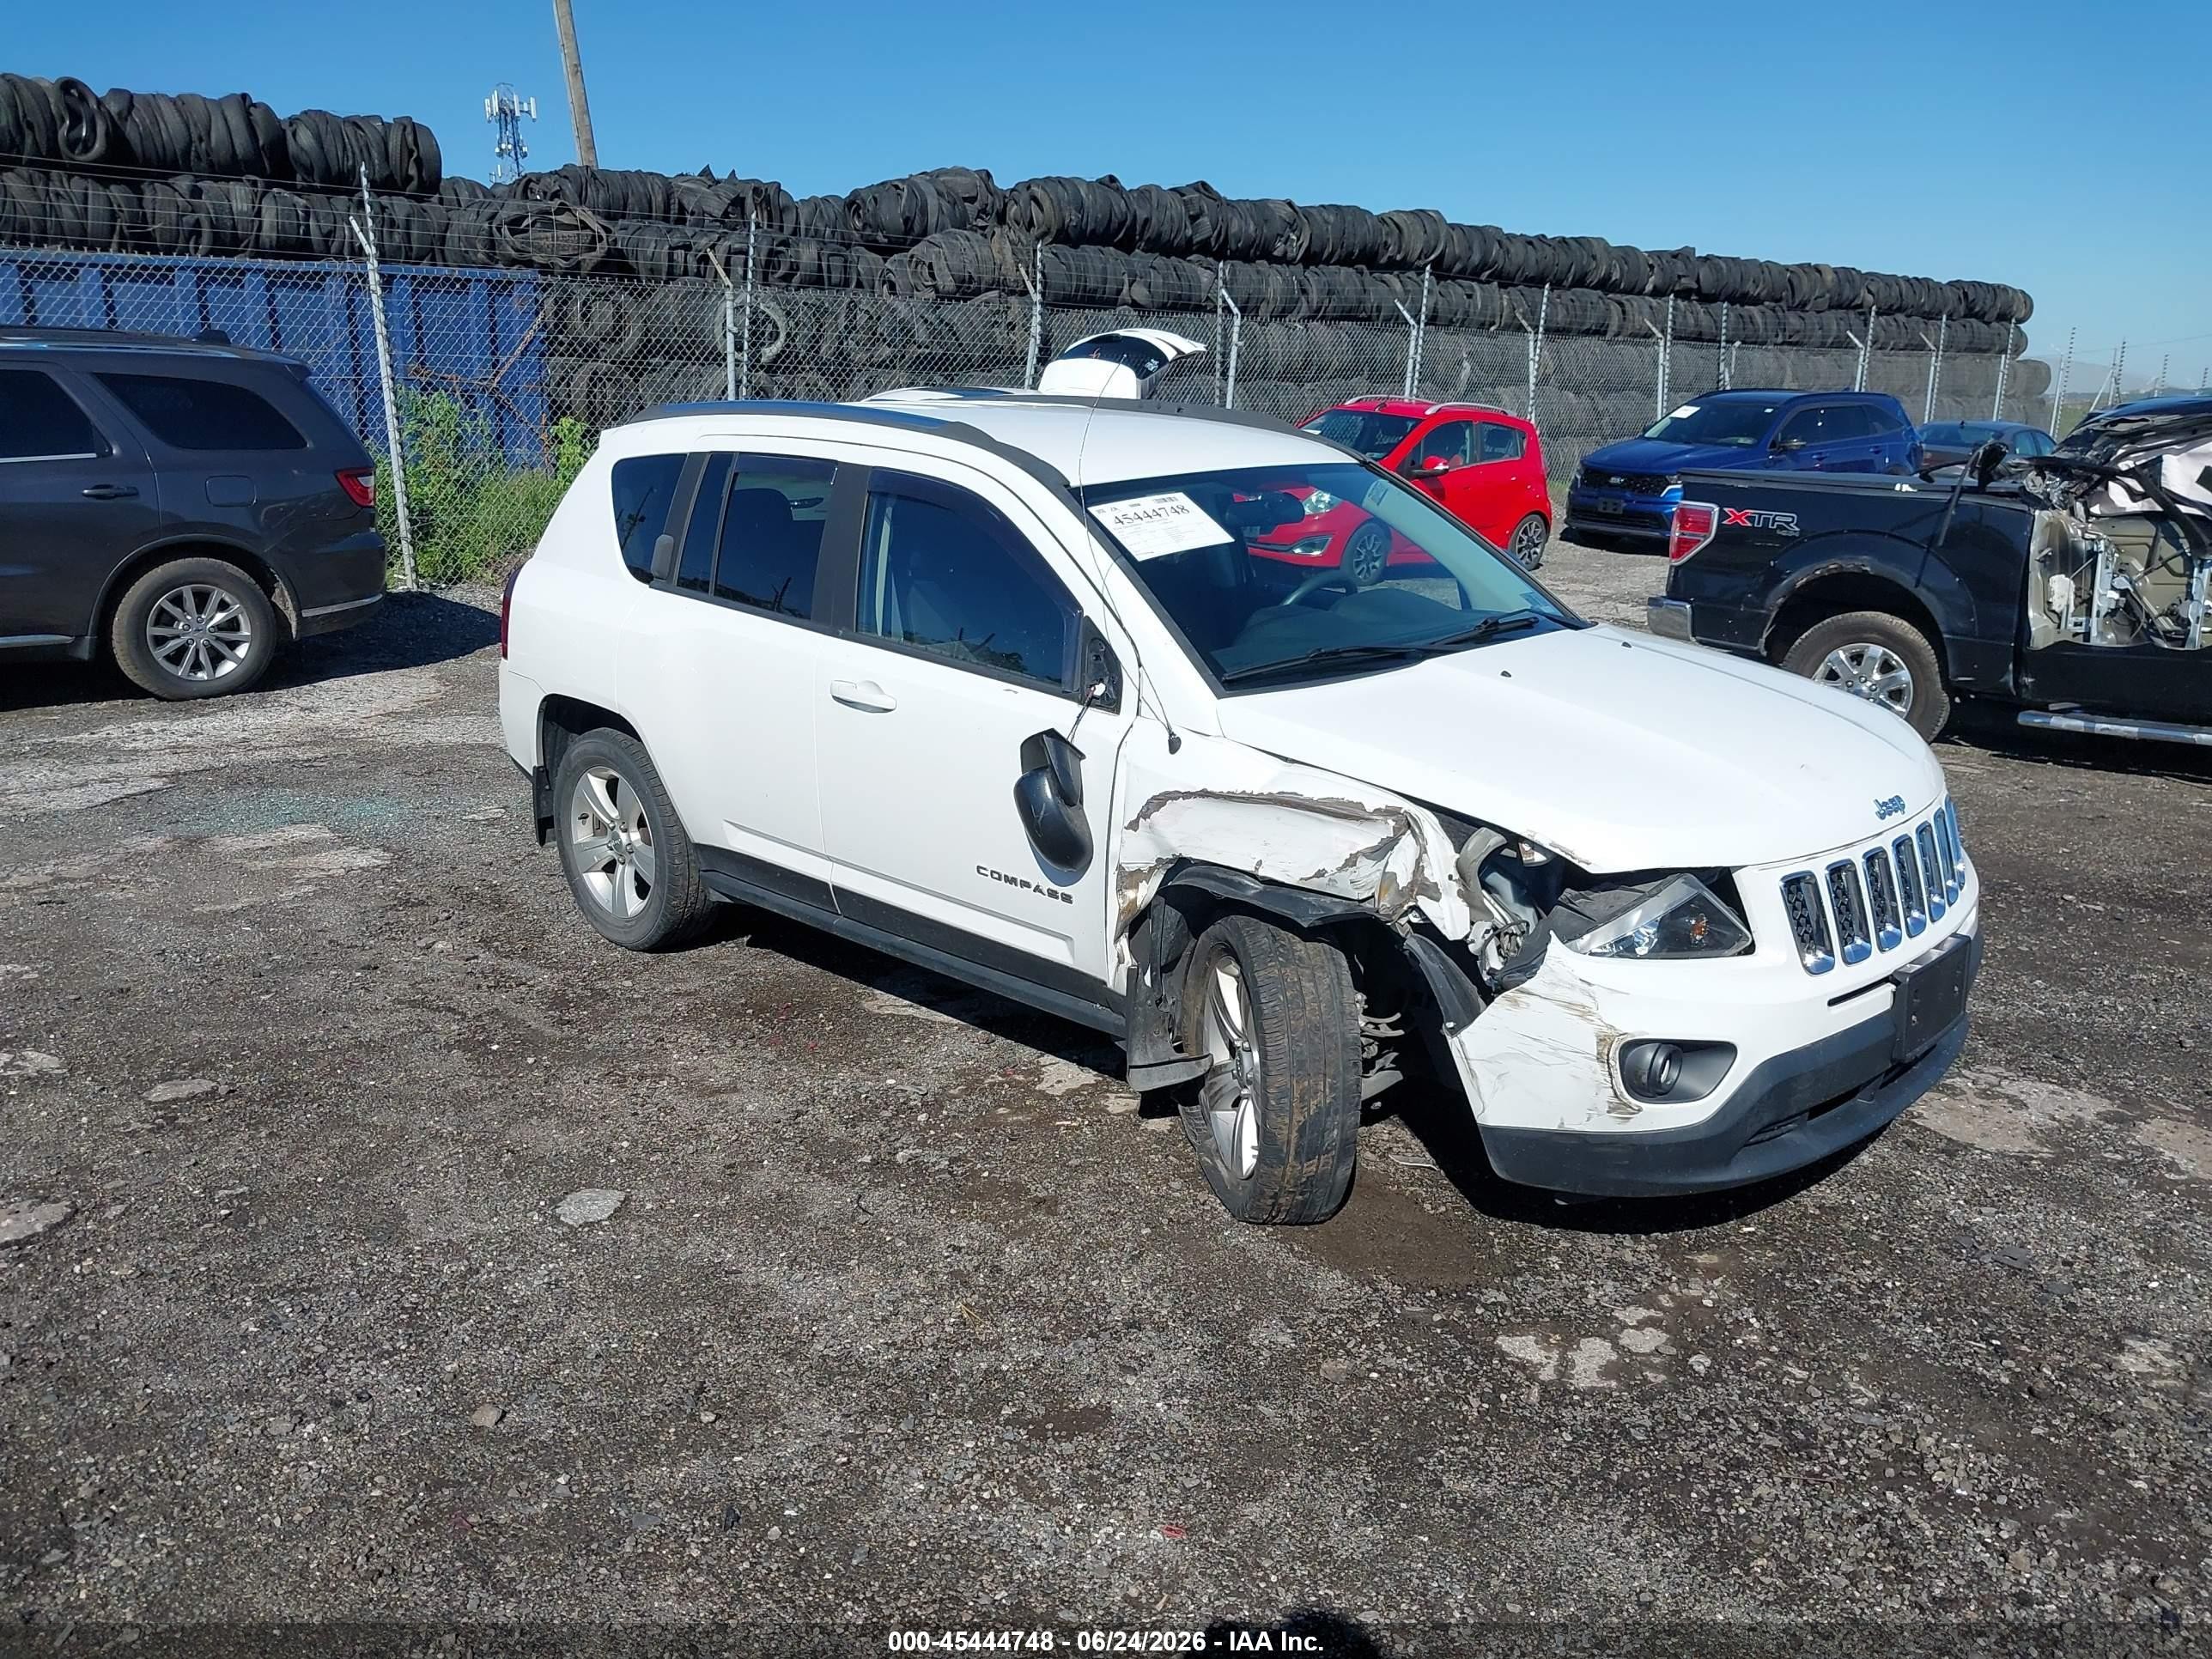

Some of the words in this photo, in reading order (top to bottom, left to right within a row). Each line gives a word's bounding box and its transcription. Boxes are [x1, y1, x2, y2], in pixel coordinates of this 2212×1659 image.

[1114, 504, 1190, 526] 45444748
[1722, 507, 1800, 531] XTR
[1874, 795, 1905, 820] Jeep
[975, 865, 1073, 904] COMPASS
